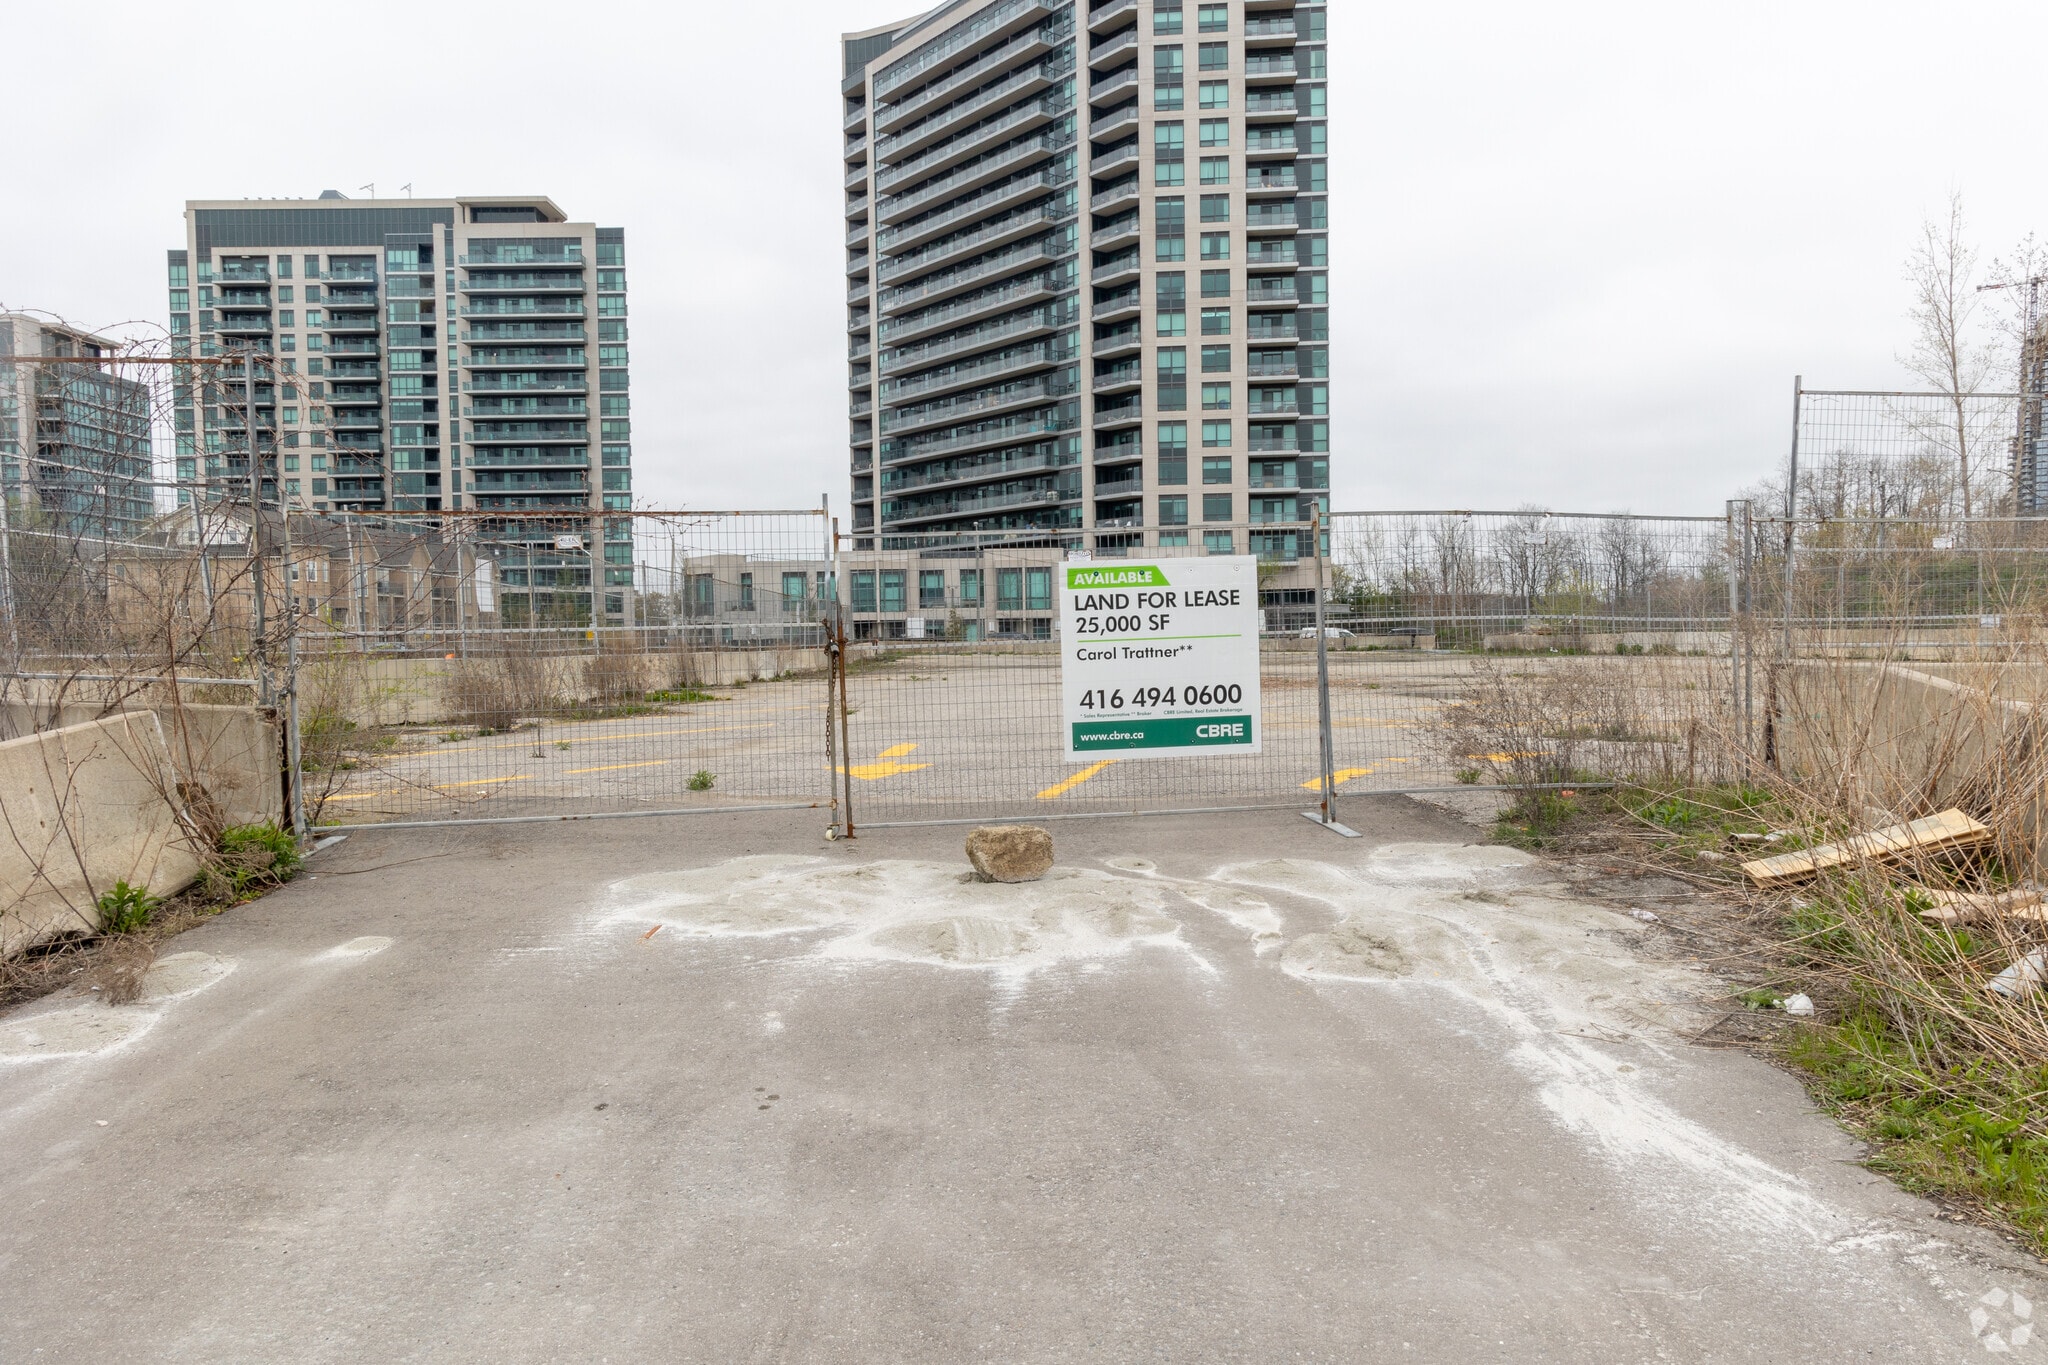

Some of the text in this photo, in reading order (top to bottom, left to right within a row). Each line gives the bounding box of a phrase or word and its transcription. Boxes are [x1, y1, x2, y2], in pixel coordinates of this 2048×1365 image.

[1074, 571, 1153, 585] AVAILABLE
[1075, 589, 1240, 611] LAND FOR LEASE
[1076, 614, 1170, 636] 25,000 SF
[1077, 647, 1117, 661] Carol
[1080, 684, 1242, 709] 416 494 0600
[1080, 731, 1144, 741] www.cbre.ca
[1196, 723, 1244, 738] CBRE
